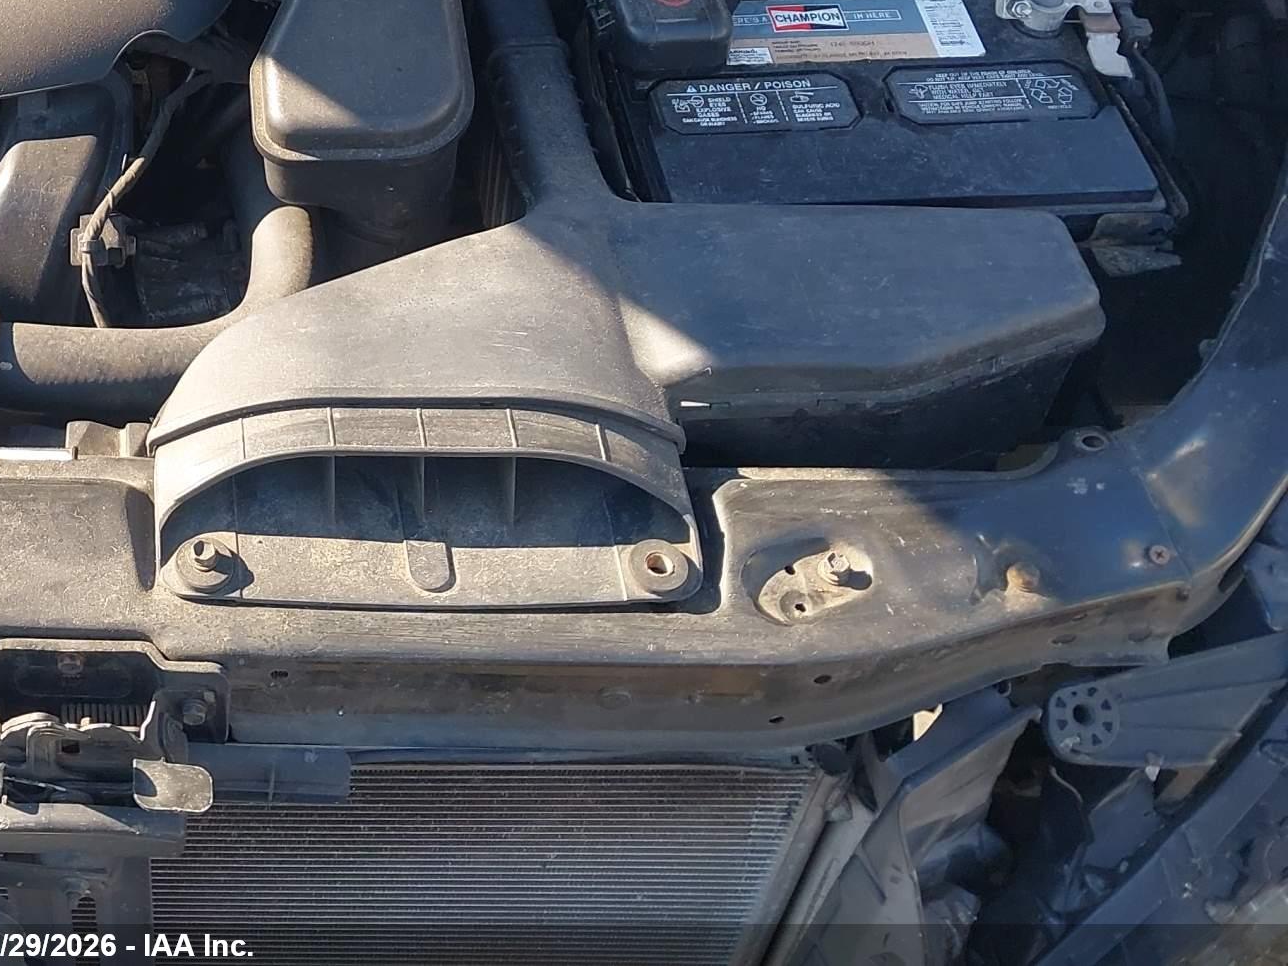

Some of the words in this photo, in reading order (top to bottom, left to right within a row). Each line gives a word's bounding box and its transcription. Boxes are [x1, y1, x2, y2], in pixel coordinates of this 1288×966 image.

[732, 16, 760, 24] ERE'S
[775, 10, 840, 23] CHAMPION
[866, 10, 891, 18] HERE
[699, 82, 751, 92] DANGER
[764, 79, 810, 89] POISON
